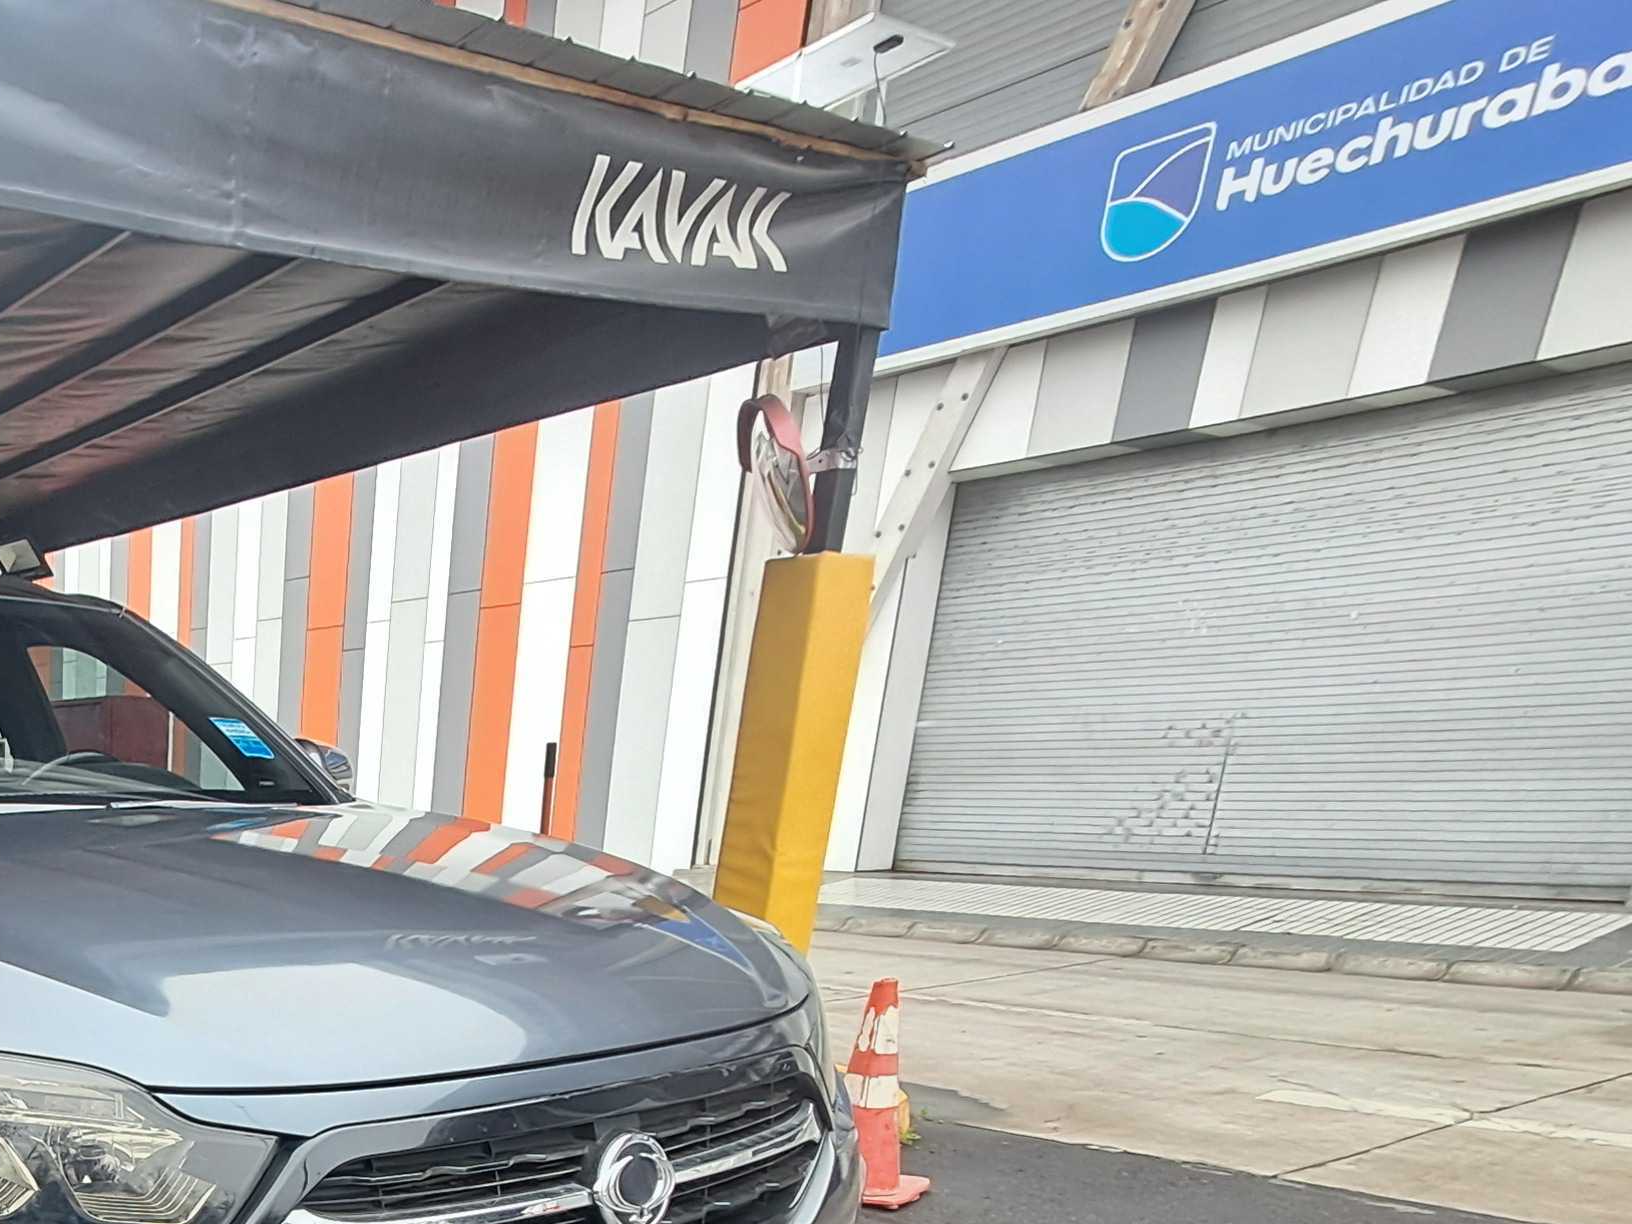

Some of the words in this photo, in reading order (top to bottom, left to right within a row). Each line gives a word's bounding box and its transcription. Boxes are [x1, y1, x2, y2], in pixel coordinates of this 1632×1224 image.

[1215, 50, 1632, 212] Huechuraba
[1225, 60, 1485, 161] MUNICIPALIDAD
[1498, 33, 1557, 73] DE
[571, 153, 792, 272] KAVAK
